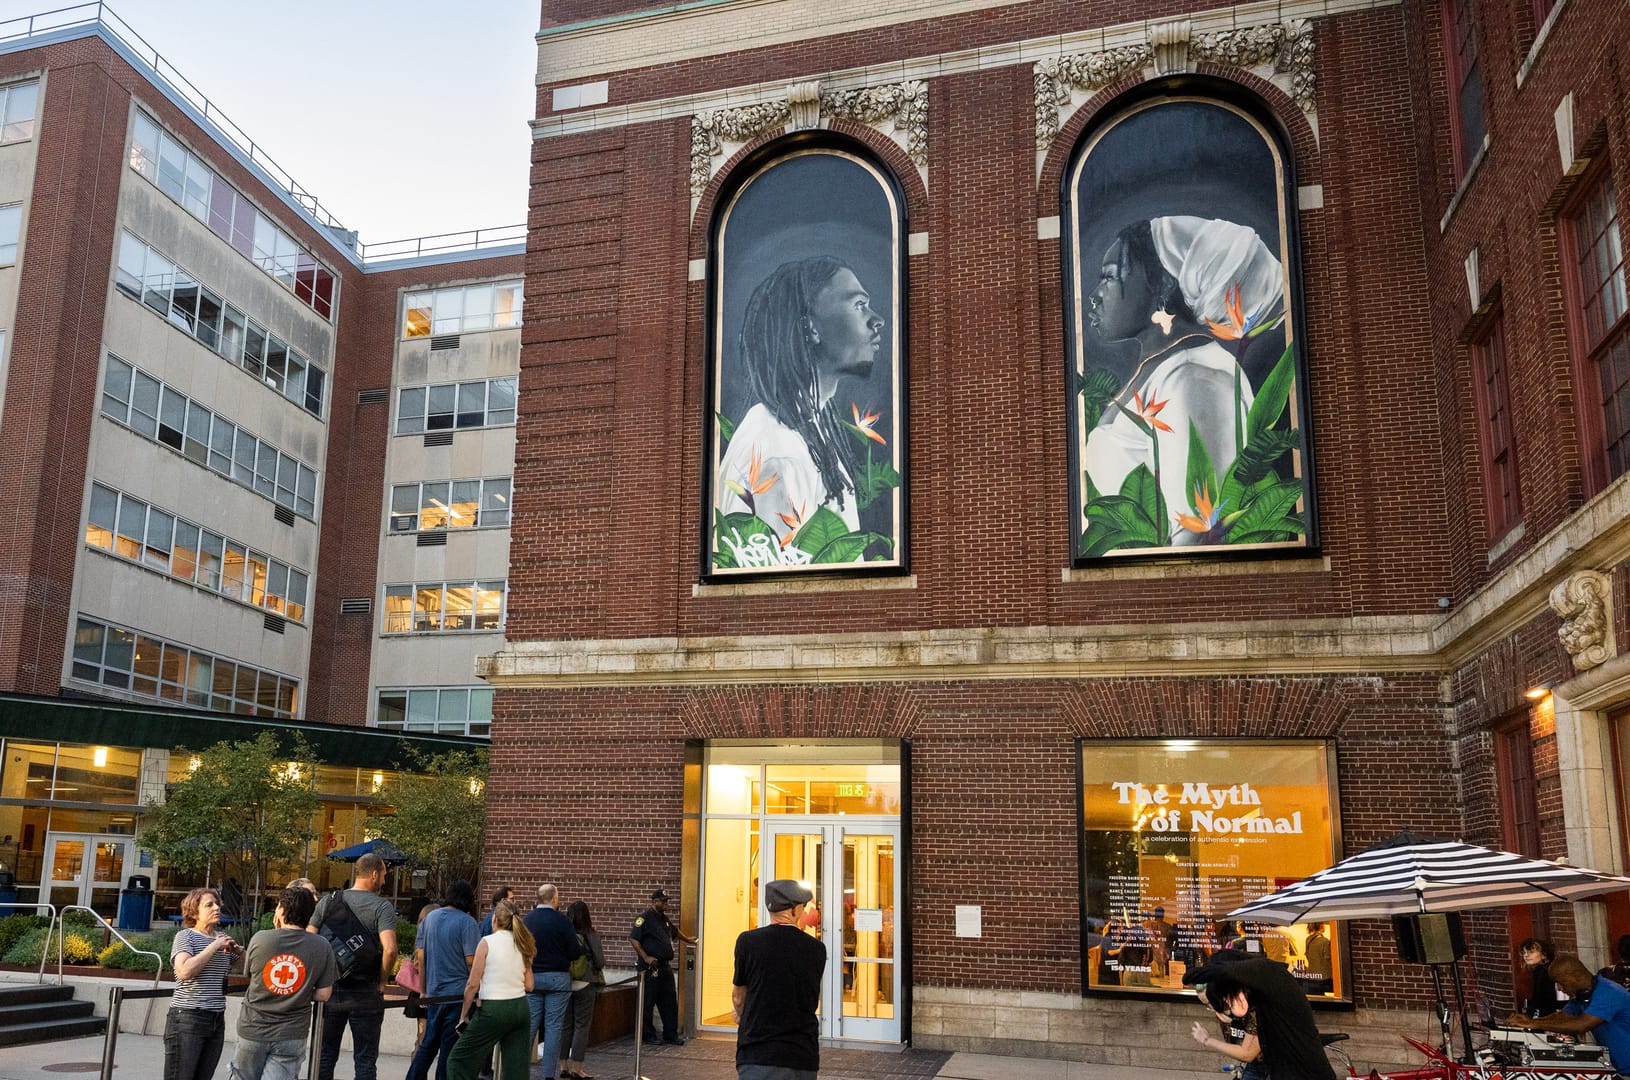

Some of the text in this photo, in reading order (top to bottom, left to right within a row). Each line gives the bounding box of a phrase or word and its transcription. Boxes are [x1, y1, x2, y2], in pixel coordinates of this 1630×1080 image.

[1112, 781, 1261, 810] The Myth
[1151, 810, 1304, 834] of Normal
[1151, 835, 1188, 843] celebration
[1189, 835, 1196, 843] of
[1197, 836, 1229, 844] authentic
[1230, 837, 1267, 845] exession
[271, 954, 304, 968] SAFETY
[1125, 965, 1152, 973] YEARS
[268, 984, 294, 995] FIRST
